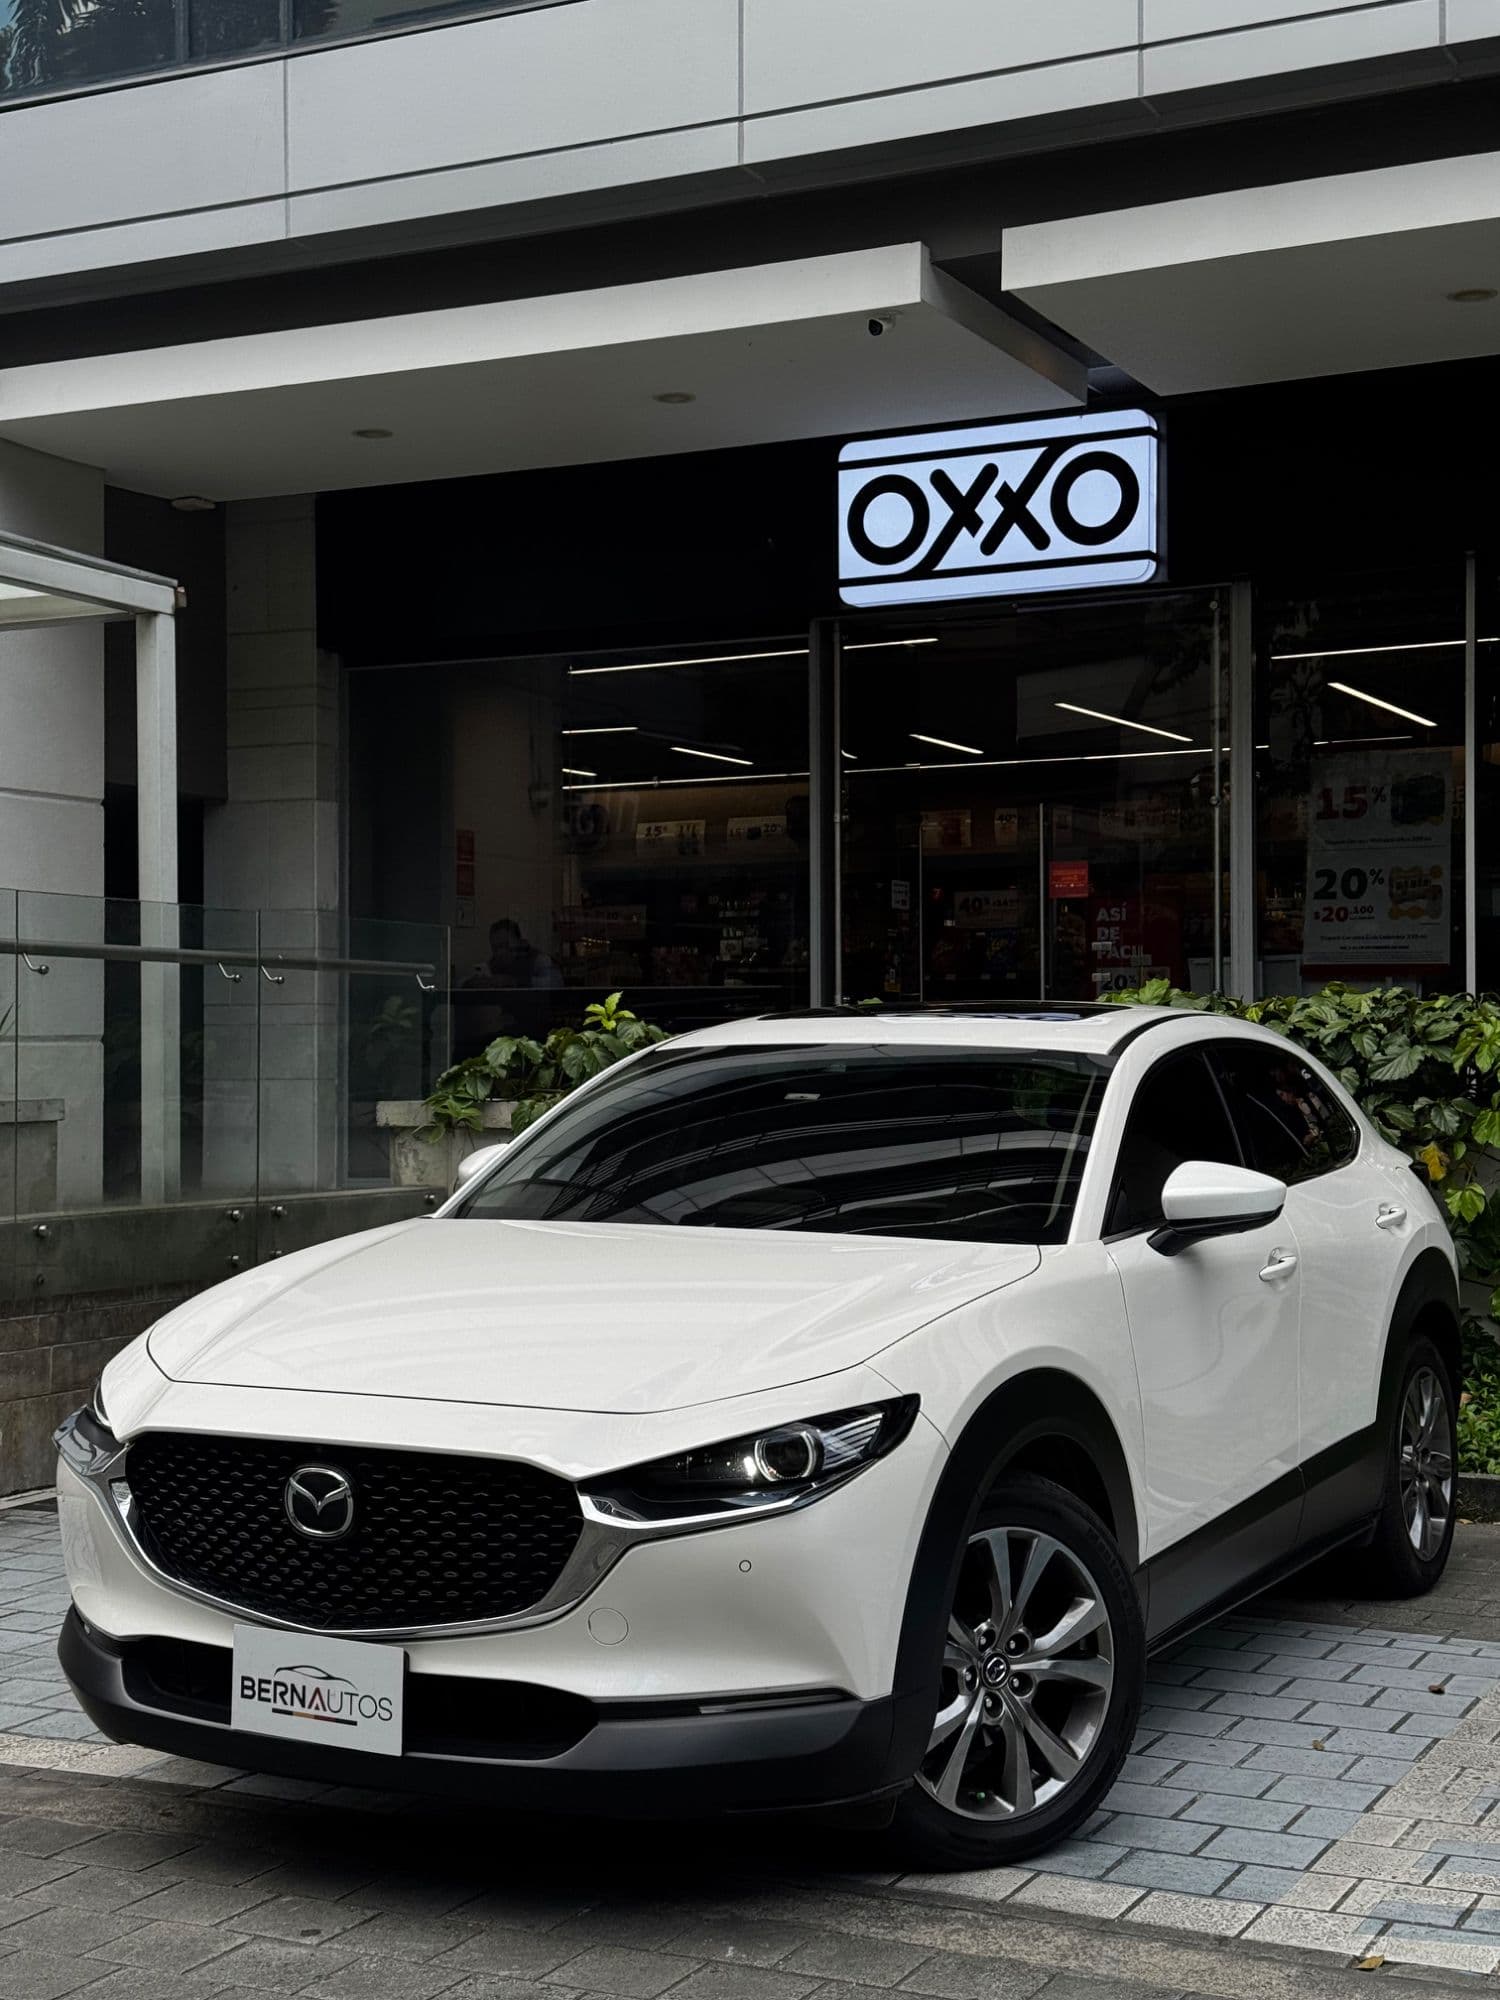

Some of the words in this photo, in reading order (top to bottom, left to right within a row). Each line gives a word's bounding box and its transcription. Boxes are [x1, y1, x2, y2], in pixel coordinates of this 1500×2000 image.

[846, 446, 1140, 568] OXXO
[1316, 785, 1387, 821] 15%
[1312, 868, 1384, 900] 20%
[1096, 901, 1127, 922] ASÍ
[1096, 926, 1121, 942] DE
[240, 1676, 393, 1721] BERNAUTOS
